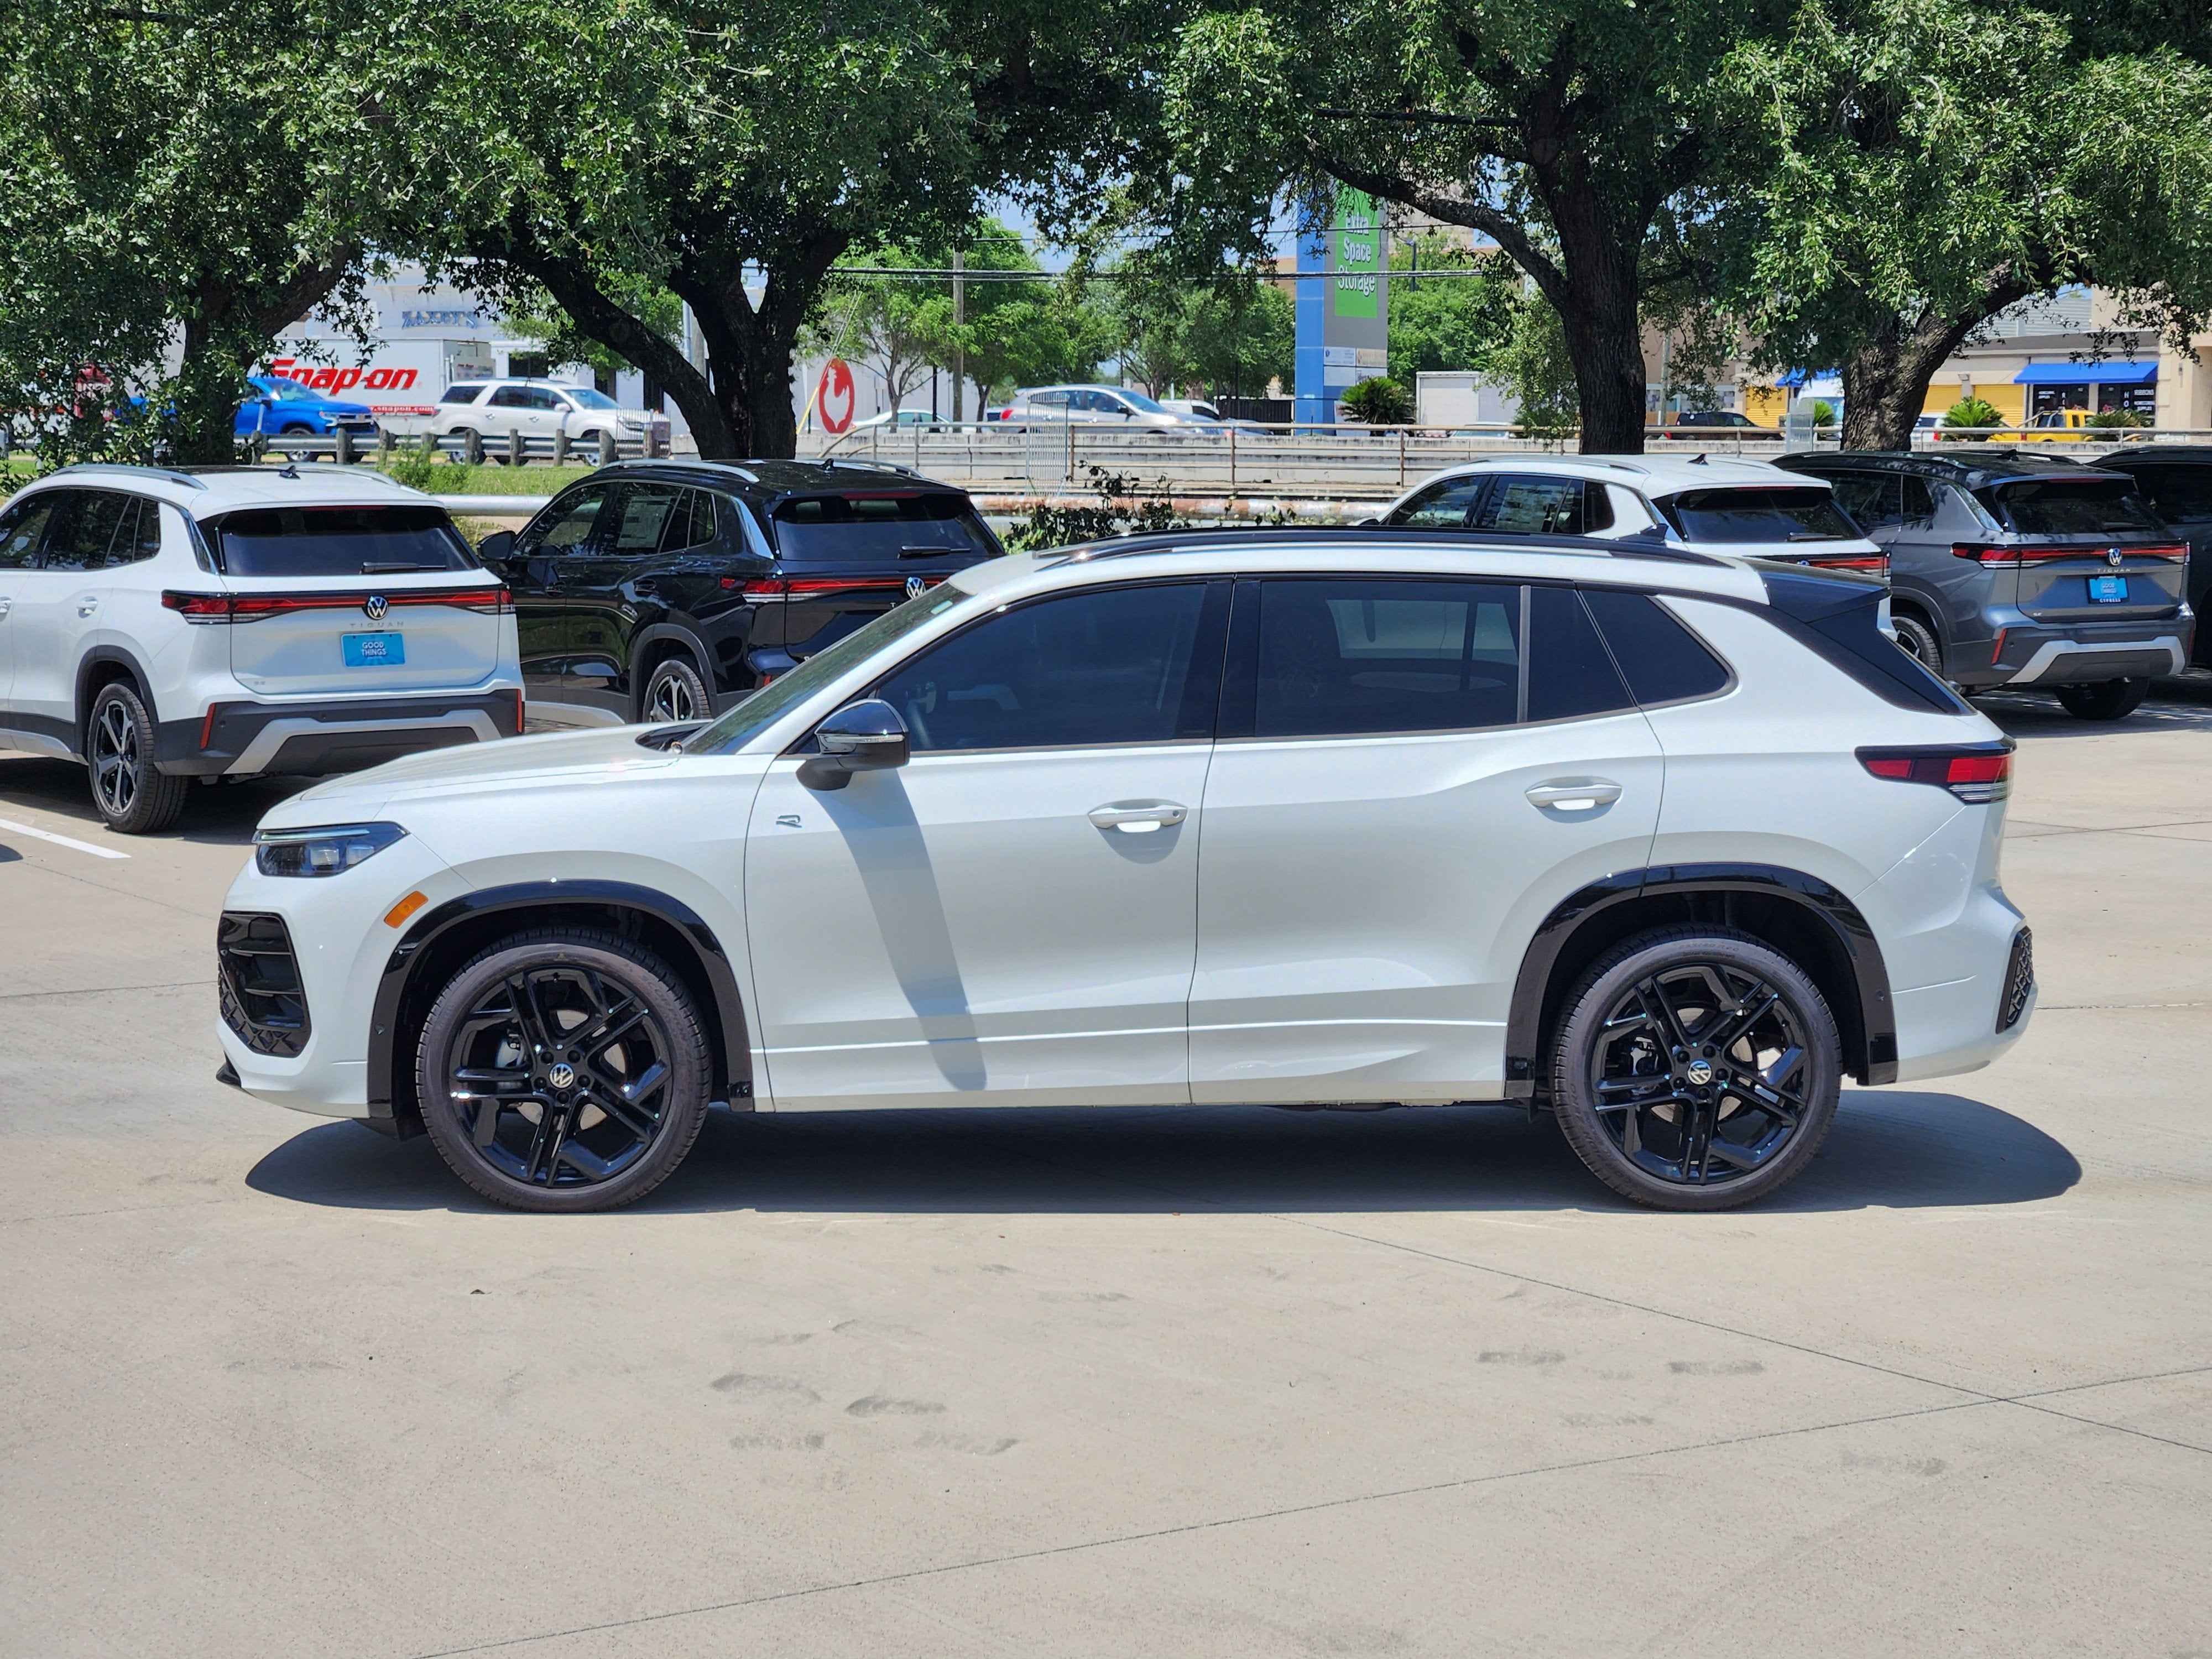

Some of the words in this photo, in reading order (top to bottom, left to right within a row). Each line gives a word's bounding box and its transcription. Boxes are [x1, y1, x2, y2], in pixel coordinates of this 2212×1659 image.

[1345, 211, 1369, 235] Extra
[1343, 236, 1371, 266] Space
[1338, 264, 1375, 296] Storage
[272, 358, 418, 395] Snap-on
